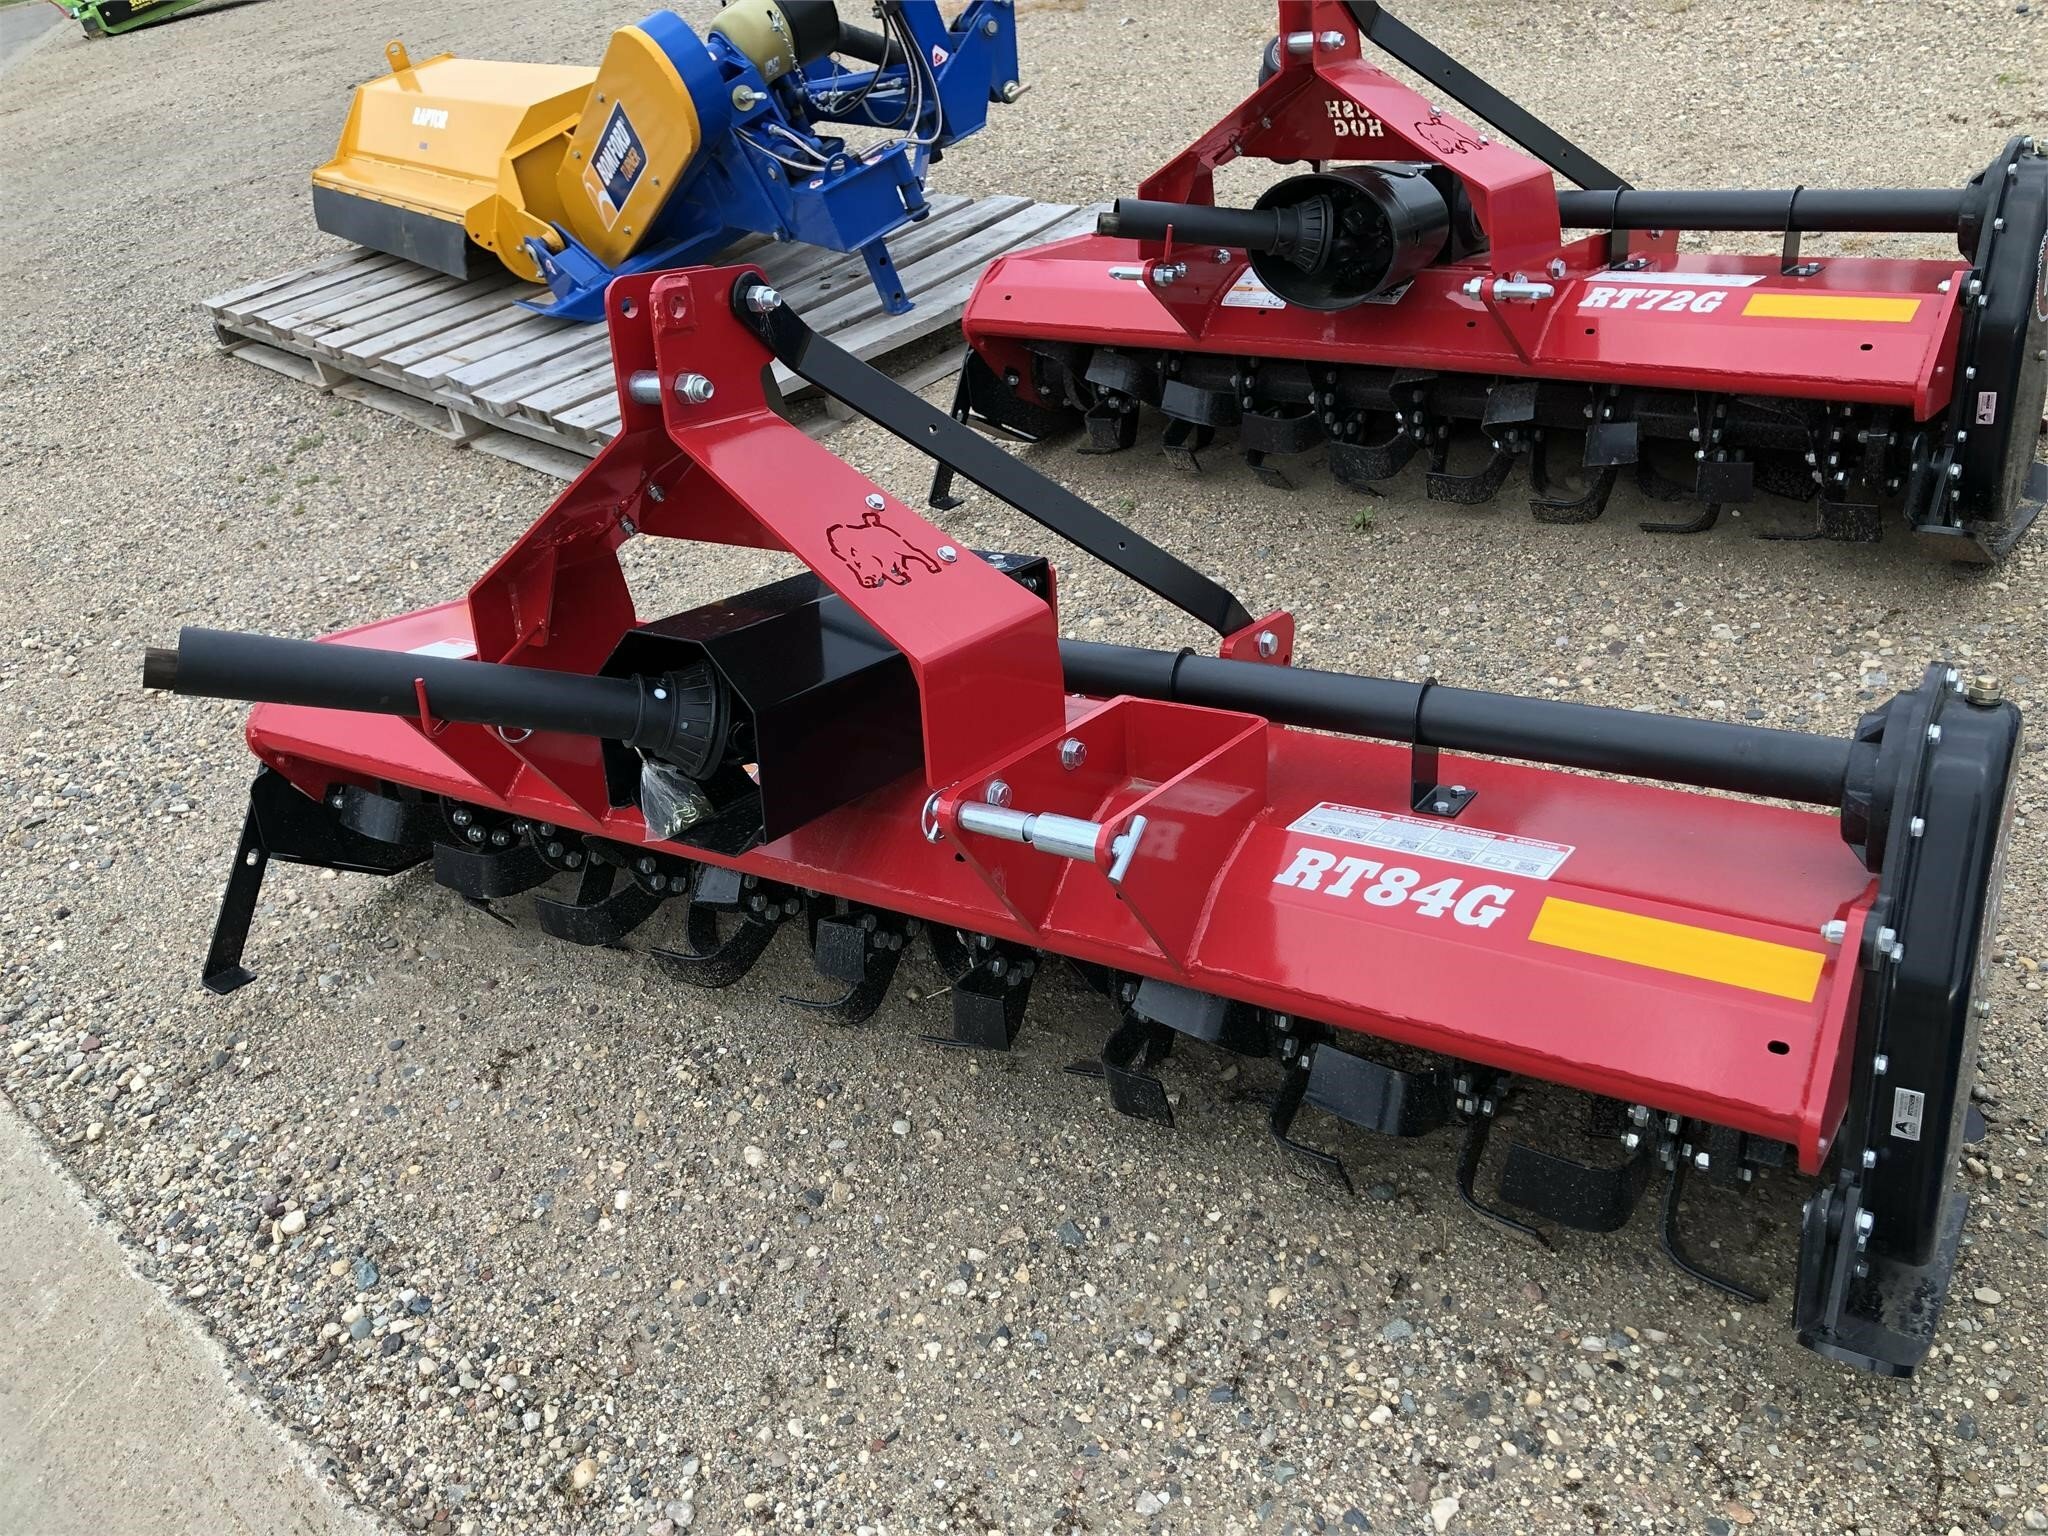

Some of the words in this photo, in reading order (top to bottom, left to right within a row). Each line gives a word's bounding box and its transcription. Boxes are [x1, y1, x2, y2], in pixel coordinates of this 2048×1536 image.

[412, 106, 449, 129] RAPTOR
[595, 118, 632, 187] BOMFORD
[1577, 286, 1729, 313] RT72G
[1272, 847, 1516, 928] RT84G
